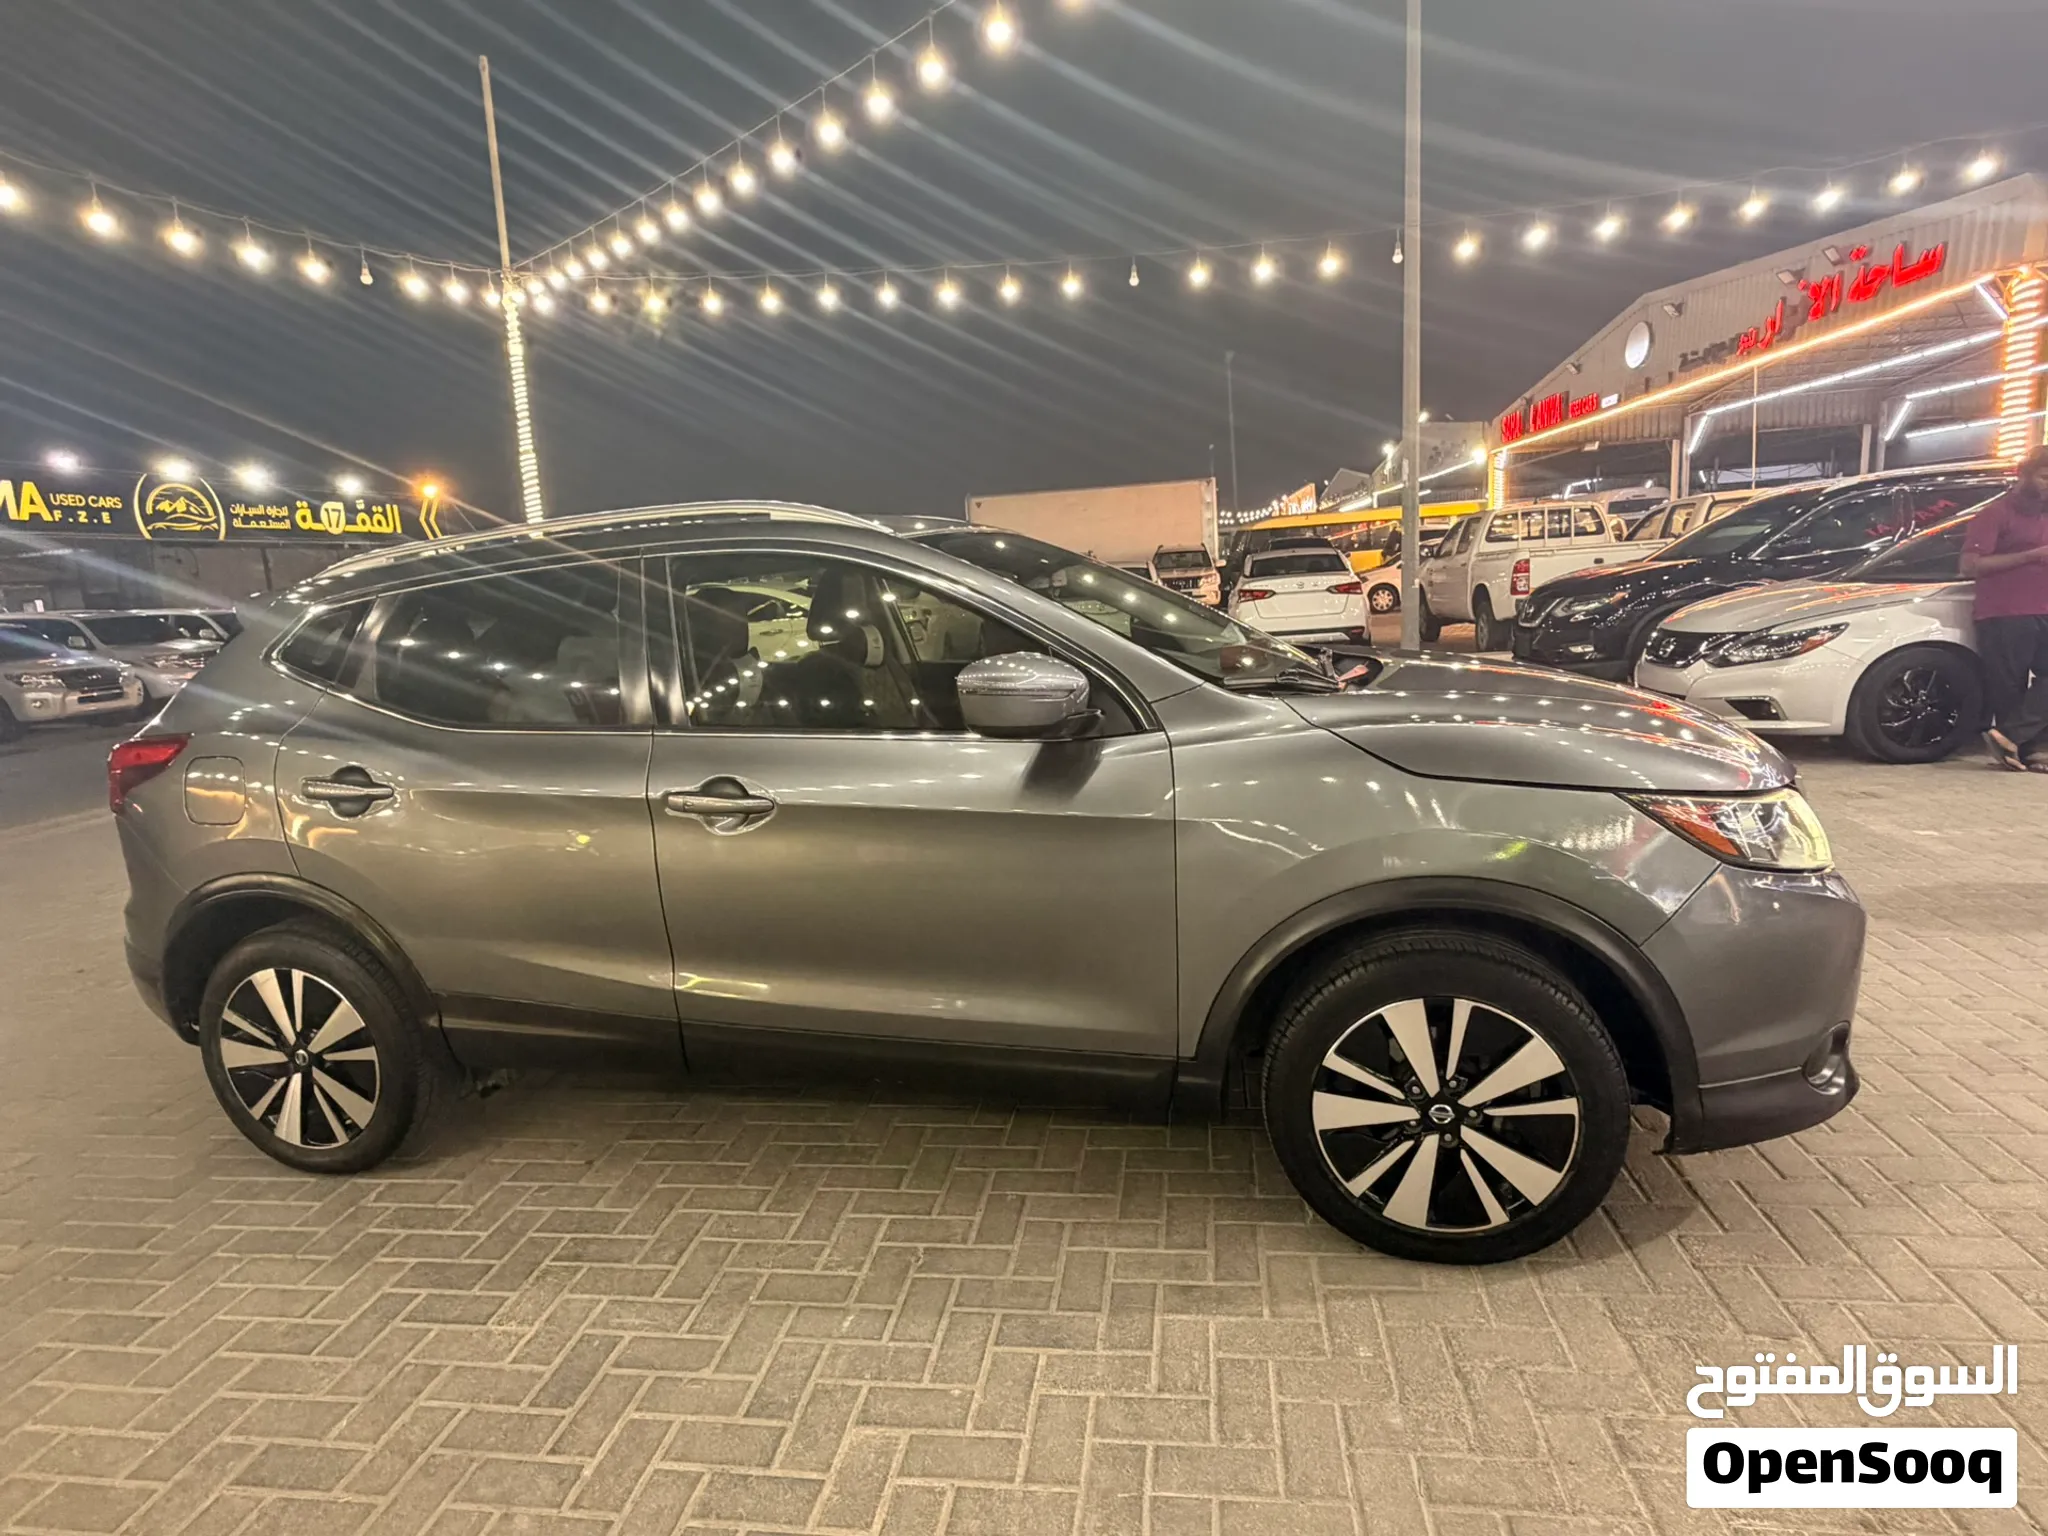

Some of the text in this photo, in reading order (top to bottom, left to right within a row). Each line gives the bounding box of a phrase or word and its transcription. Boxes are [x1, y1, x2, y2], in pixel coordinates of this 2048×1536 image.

[1848, 243, 1946, 303] ساحة
[49, 492, 122, 509] USED CARS
